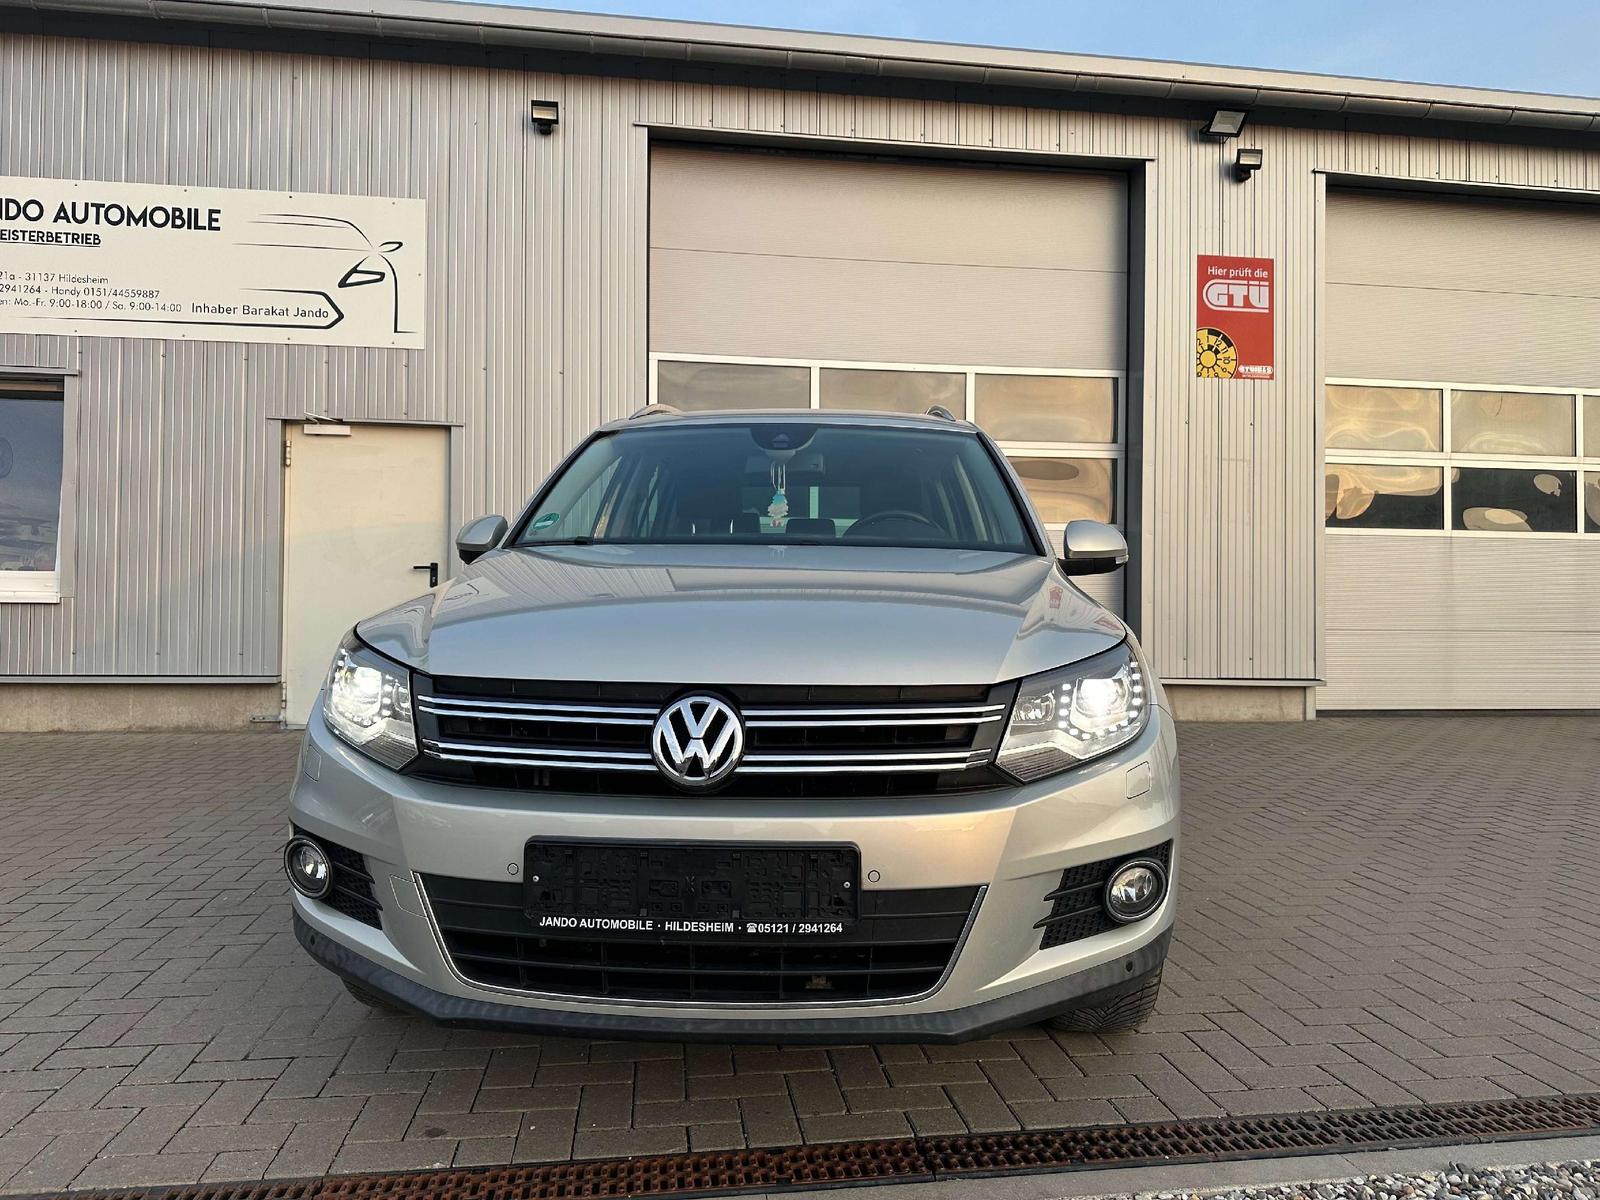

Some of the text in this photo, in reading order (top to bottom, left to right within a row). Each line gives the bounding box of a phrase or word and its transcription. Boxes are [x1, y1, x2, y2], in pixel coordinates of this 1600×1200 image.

[0, 198, 221, 232] DO AUTOMOBILE
[25, 272, 55, 282] 31137
[58, 273, 109, 285] Hildesheim
[1207, 266, 1269, 278] Hier prüft die
[0, 283, 41, 294] 2941264
[51, 286, 81, 298] Handy
[83, 287, 160, 299] 0151/44559887
[1203, 279, 1270, 313] GTÜ
[49, 298, 103, 310] 9:00-18:00
[112, 300, 127, 311] Sa.
[129, 301, 182, 313] 9:00-14:00
[191, 302, 329, 319] Inhaber Barakat Jando
[1213, 337, 1223, 348] 12
[1220, 346, 1229, 354] 11
[1222, 356, 1231, 365] 10
[653, 696, 743, 785] VW
[539, 916, 578, 928] JANDO
[579, 918, 654, 931] AUTOMOBILE
[664, 920, 734, 933] HILDESHEIM
[757, 923, 790, 934] 05121
[798, 922, 843, 934] 2941264
